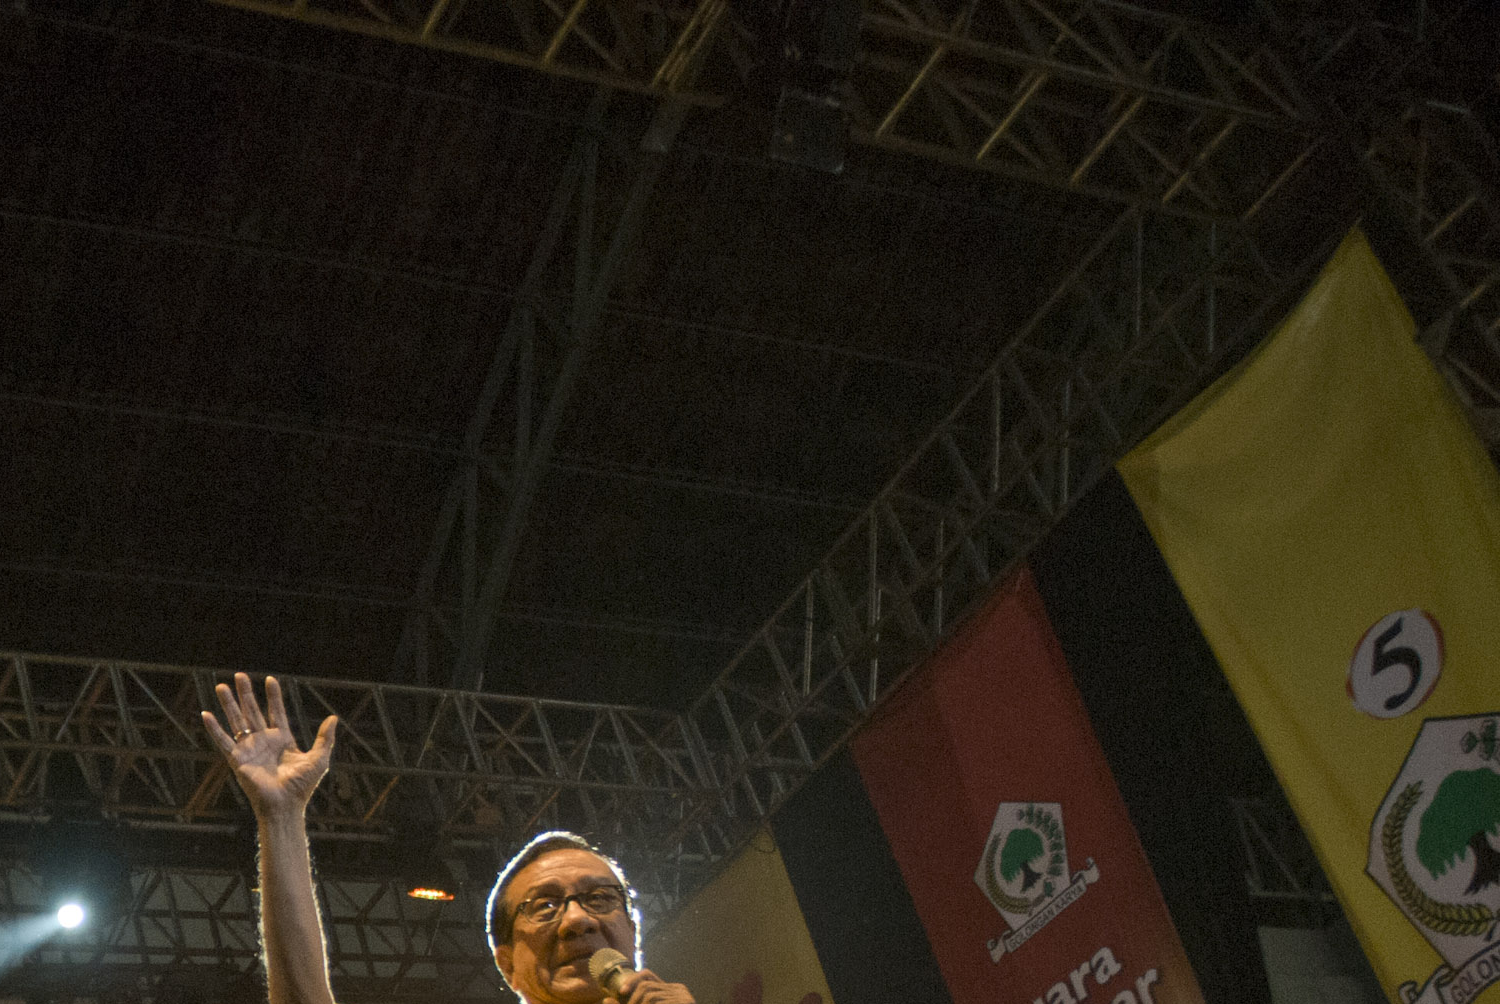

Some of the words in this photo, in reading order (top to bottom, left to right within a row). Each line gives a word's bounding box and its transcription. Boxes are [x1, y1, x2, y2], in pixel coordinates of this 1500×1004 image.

[1371, 616, 1423, 711] 5
[1008, 908, 1056, 950] GOLONGAN
[1054, 884, 1085, 913] KARYA
